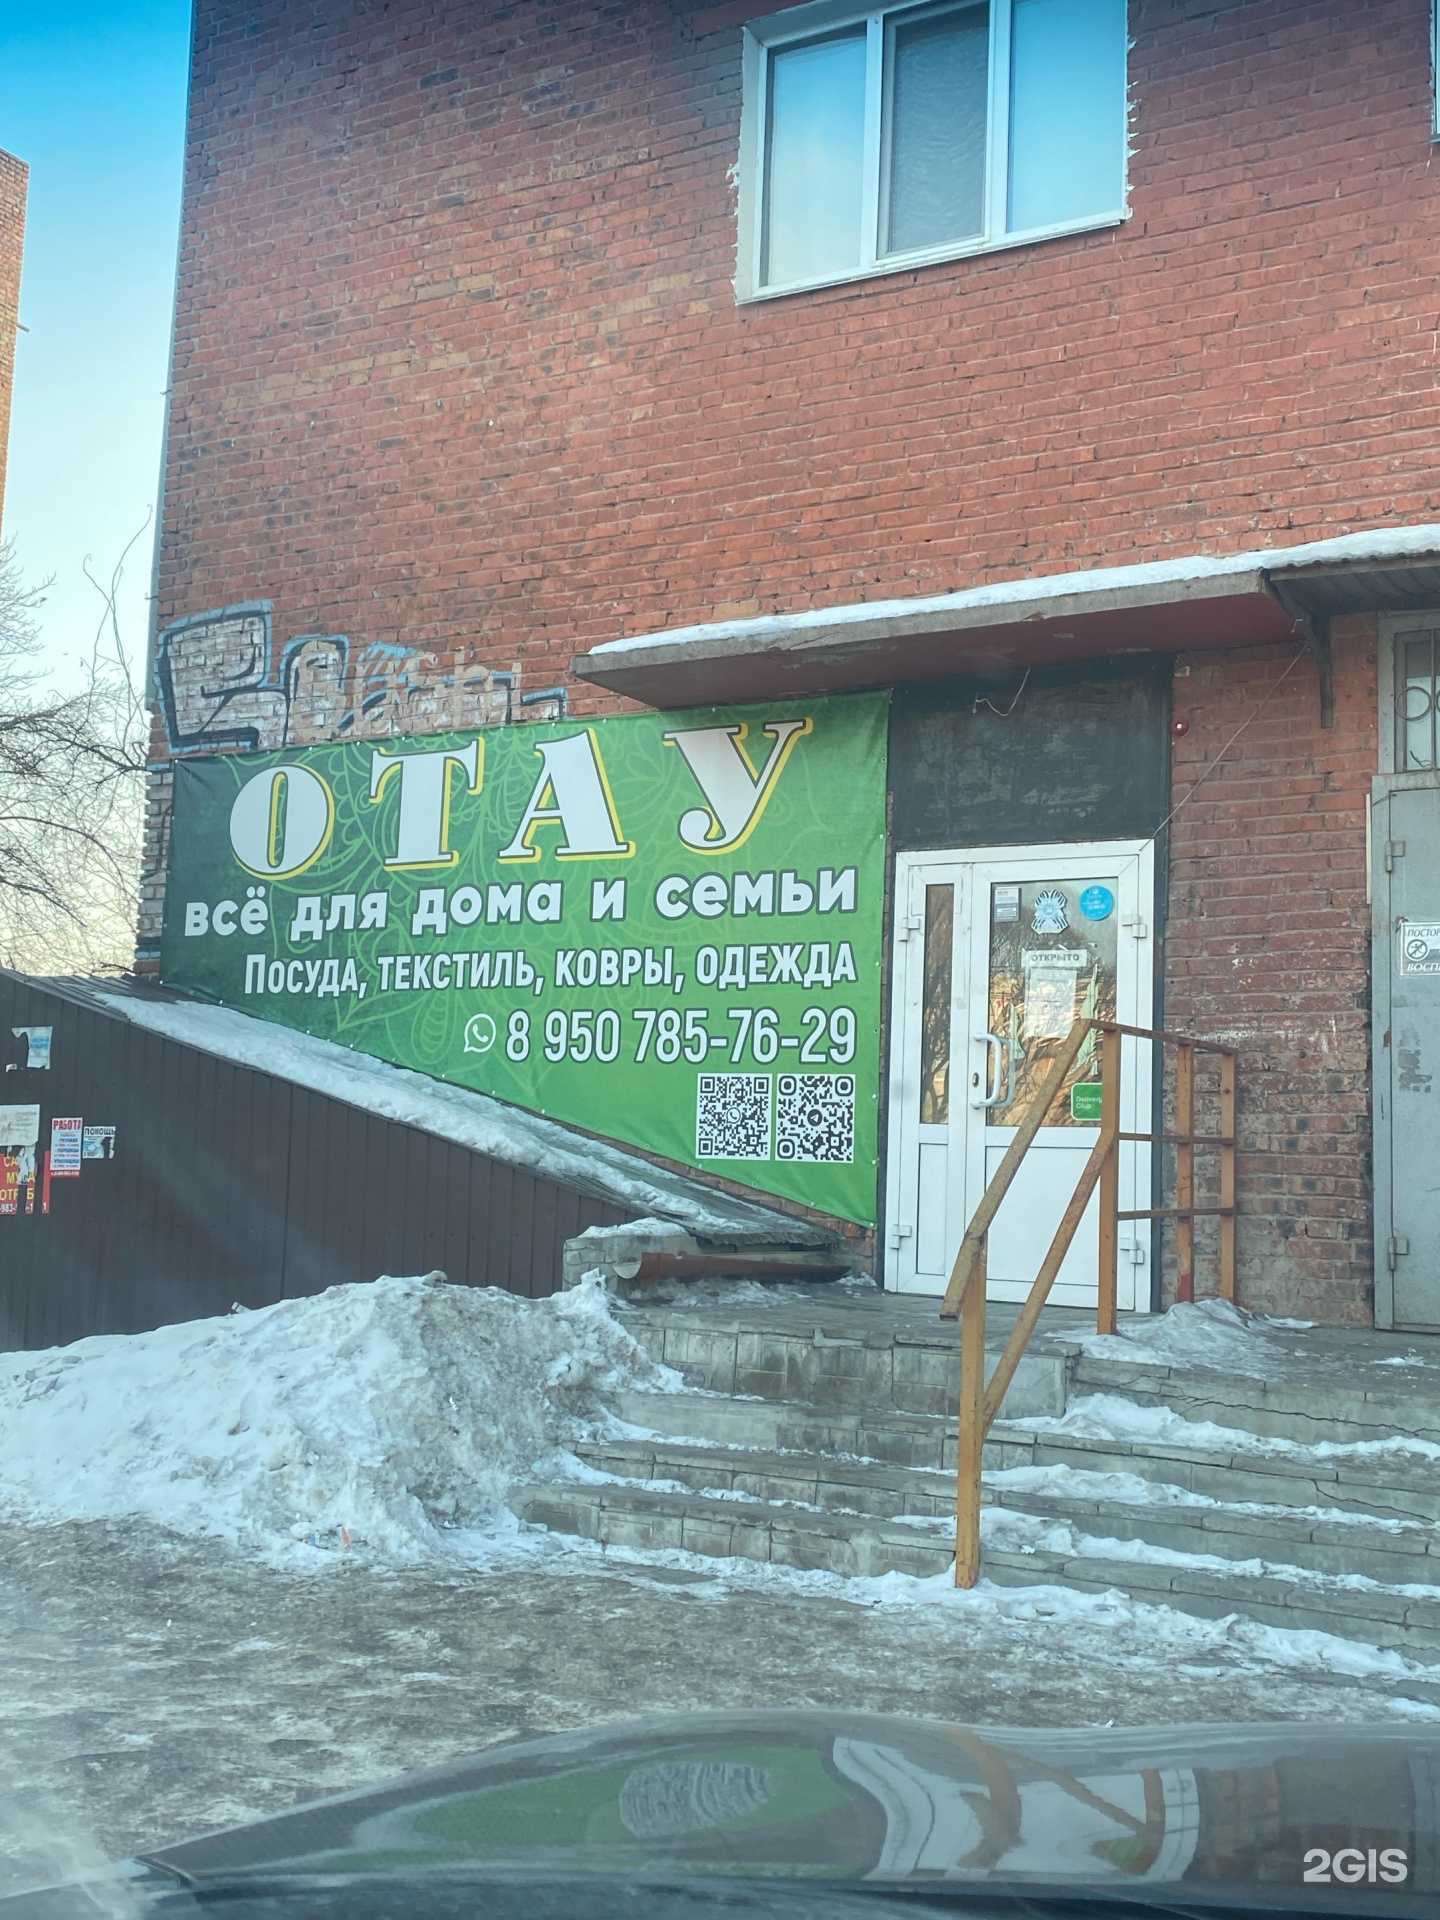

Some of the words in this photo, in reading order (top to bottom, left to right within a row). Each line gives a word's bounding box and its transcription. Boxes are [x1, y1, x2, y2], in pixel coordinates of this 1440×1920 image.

[230, 717, 813, 880] ОТАУ
[184, 886, 268, 936] всё
[290, 891, 388, 941] для
[411, 880, 563, 936] дома
[592, 879, 626, 920] и
[655, 868, 857, 920] семьи
[377, 950, 545, 997] ТЕКСТИЛЬ,
[555, 947, 685, 995] КОВРЫ,
[697, 943, 857, 989] ОДЕЖДА
[1031, 953, 1080, 961] ОТКРЫТО
[506, 1009, 531, 1063] 8
[544, 1009, 620, 1063] 950
[633, 1007, 857, 1064] 785-76-29
